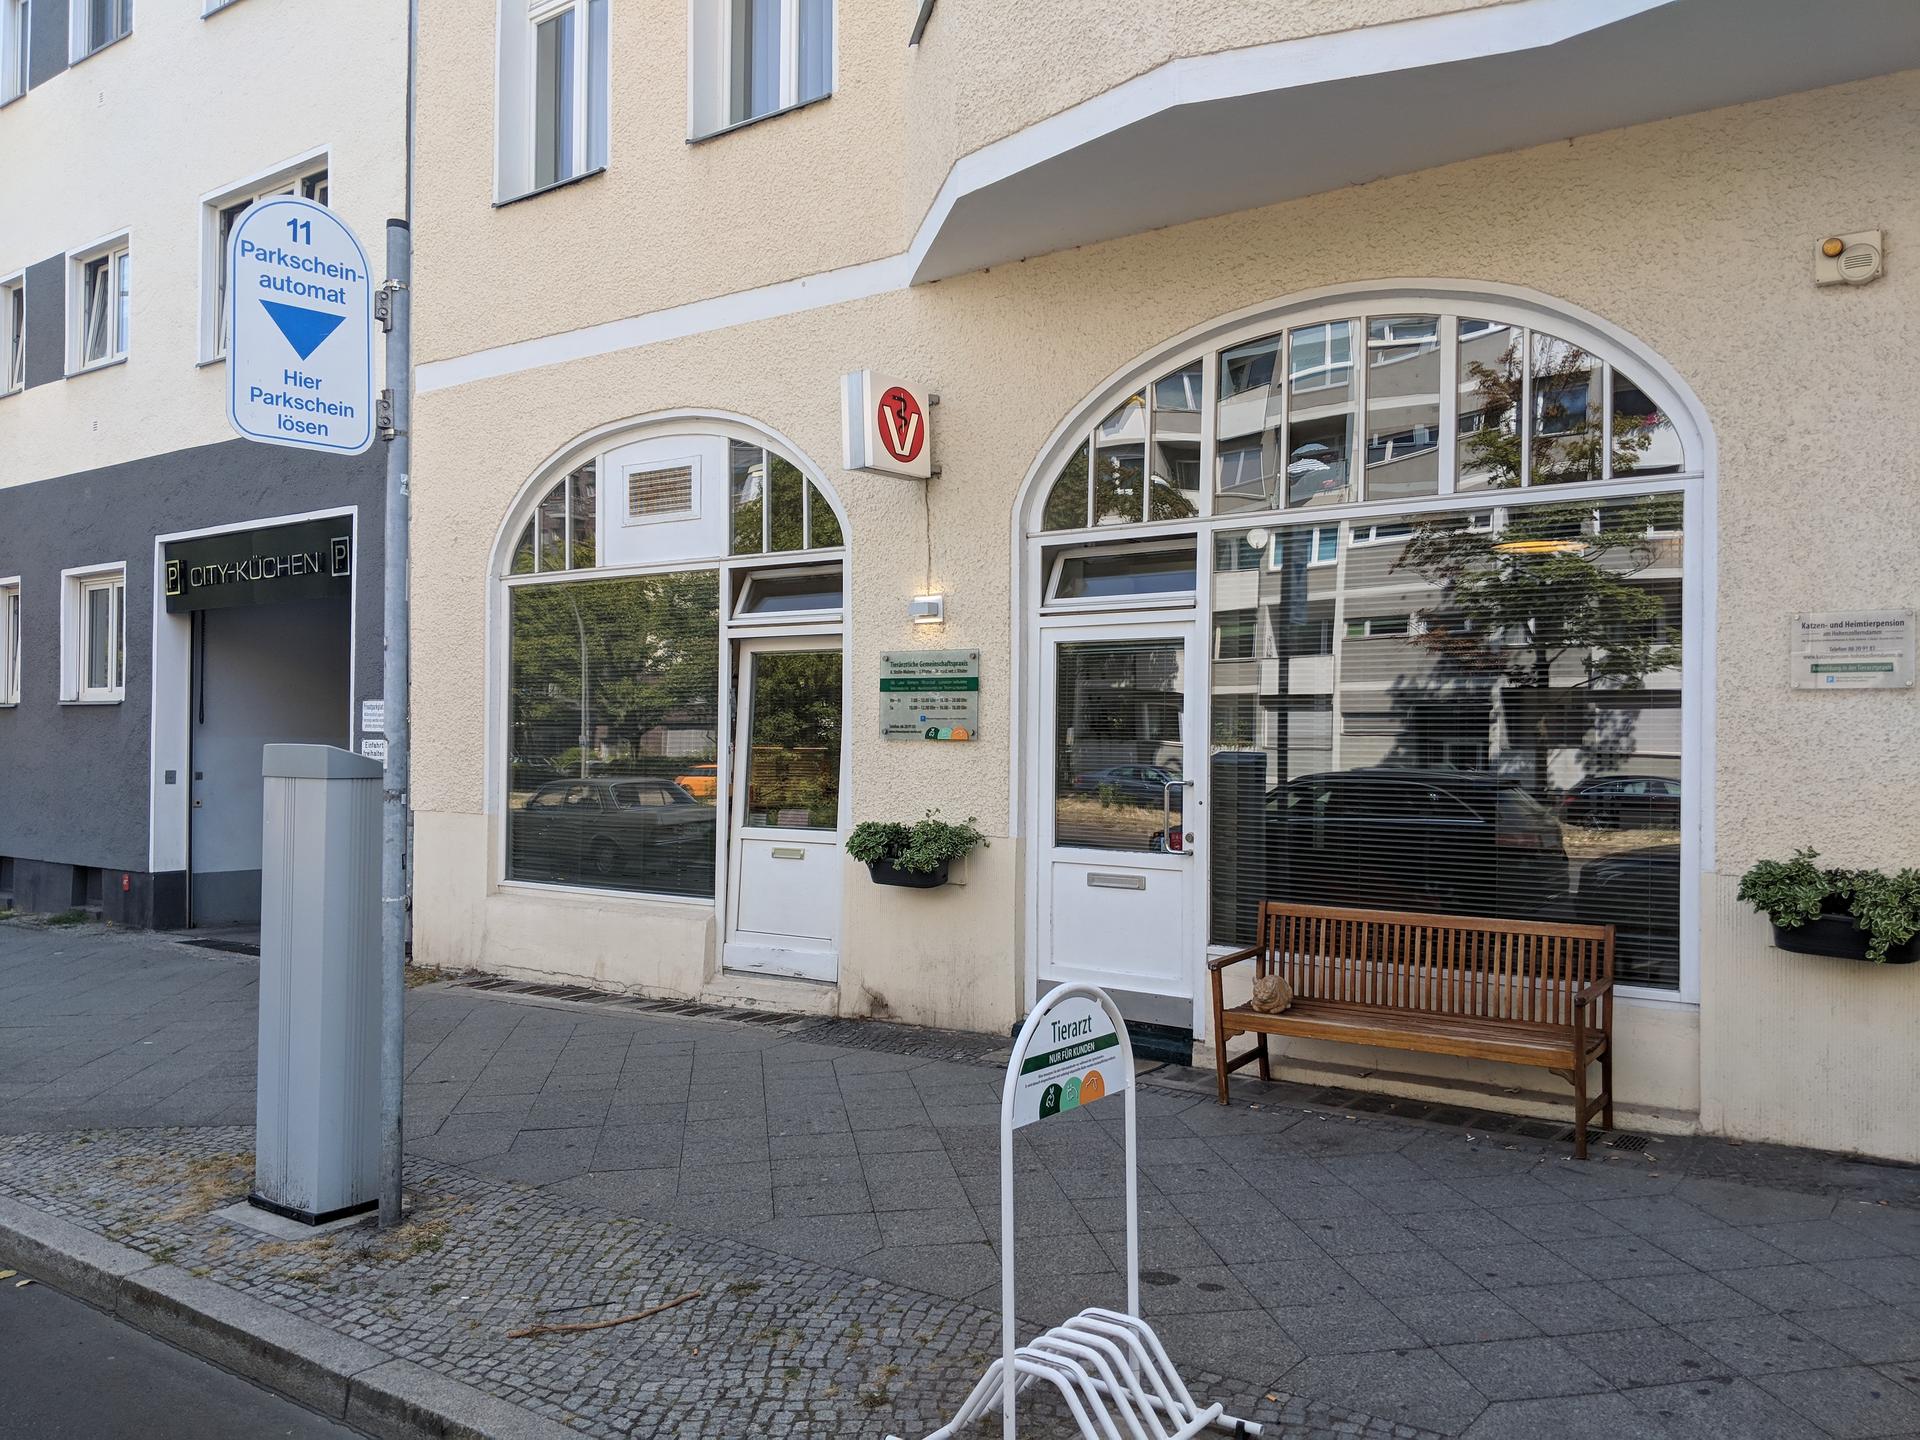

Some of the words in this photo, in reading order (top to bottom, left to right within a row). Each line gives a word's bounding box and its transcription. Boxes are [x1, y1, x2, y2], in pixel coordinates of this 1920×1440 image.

[286, 218, 311, 245] 11
[241, 239, 365, 282] Parkschein-
[259, 274, 346, 305] automat
[284, 369, 322, 390] Hier
[250, 386, 354, 418] Parkschein
[277, 413, 329, 437] lösen
[190, 551, 319, 587] CITY-KÜCHEN
[1801, 621, 1828, 630] Katzen-
[1844, 619, 1905, 628] Heimtierpension
[1051, 1014, 1092, 1044] Tierarzt
[1049, 1052, 1061, 1064] NUR
[1062, 1048, 1073, 1060] FÜR
[1073, 1042, 1095, 1058] KUNDEN
